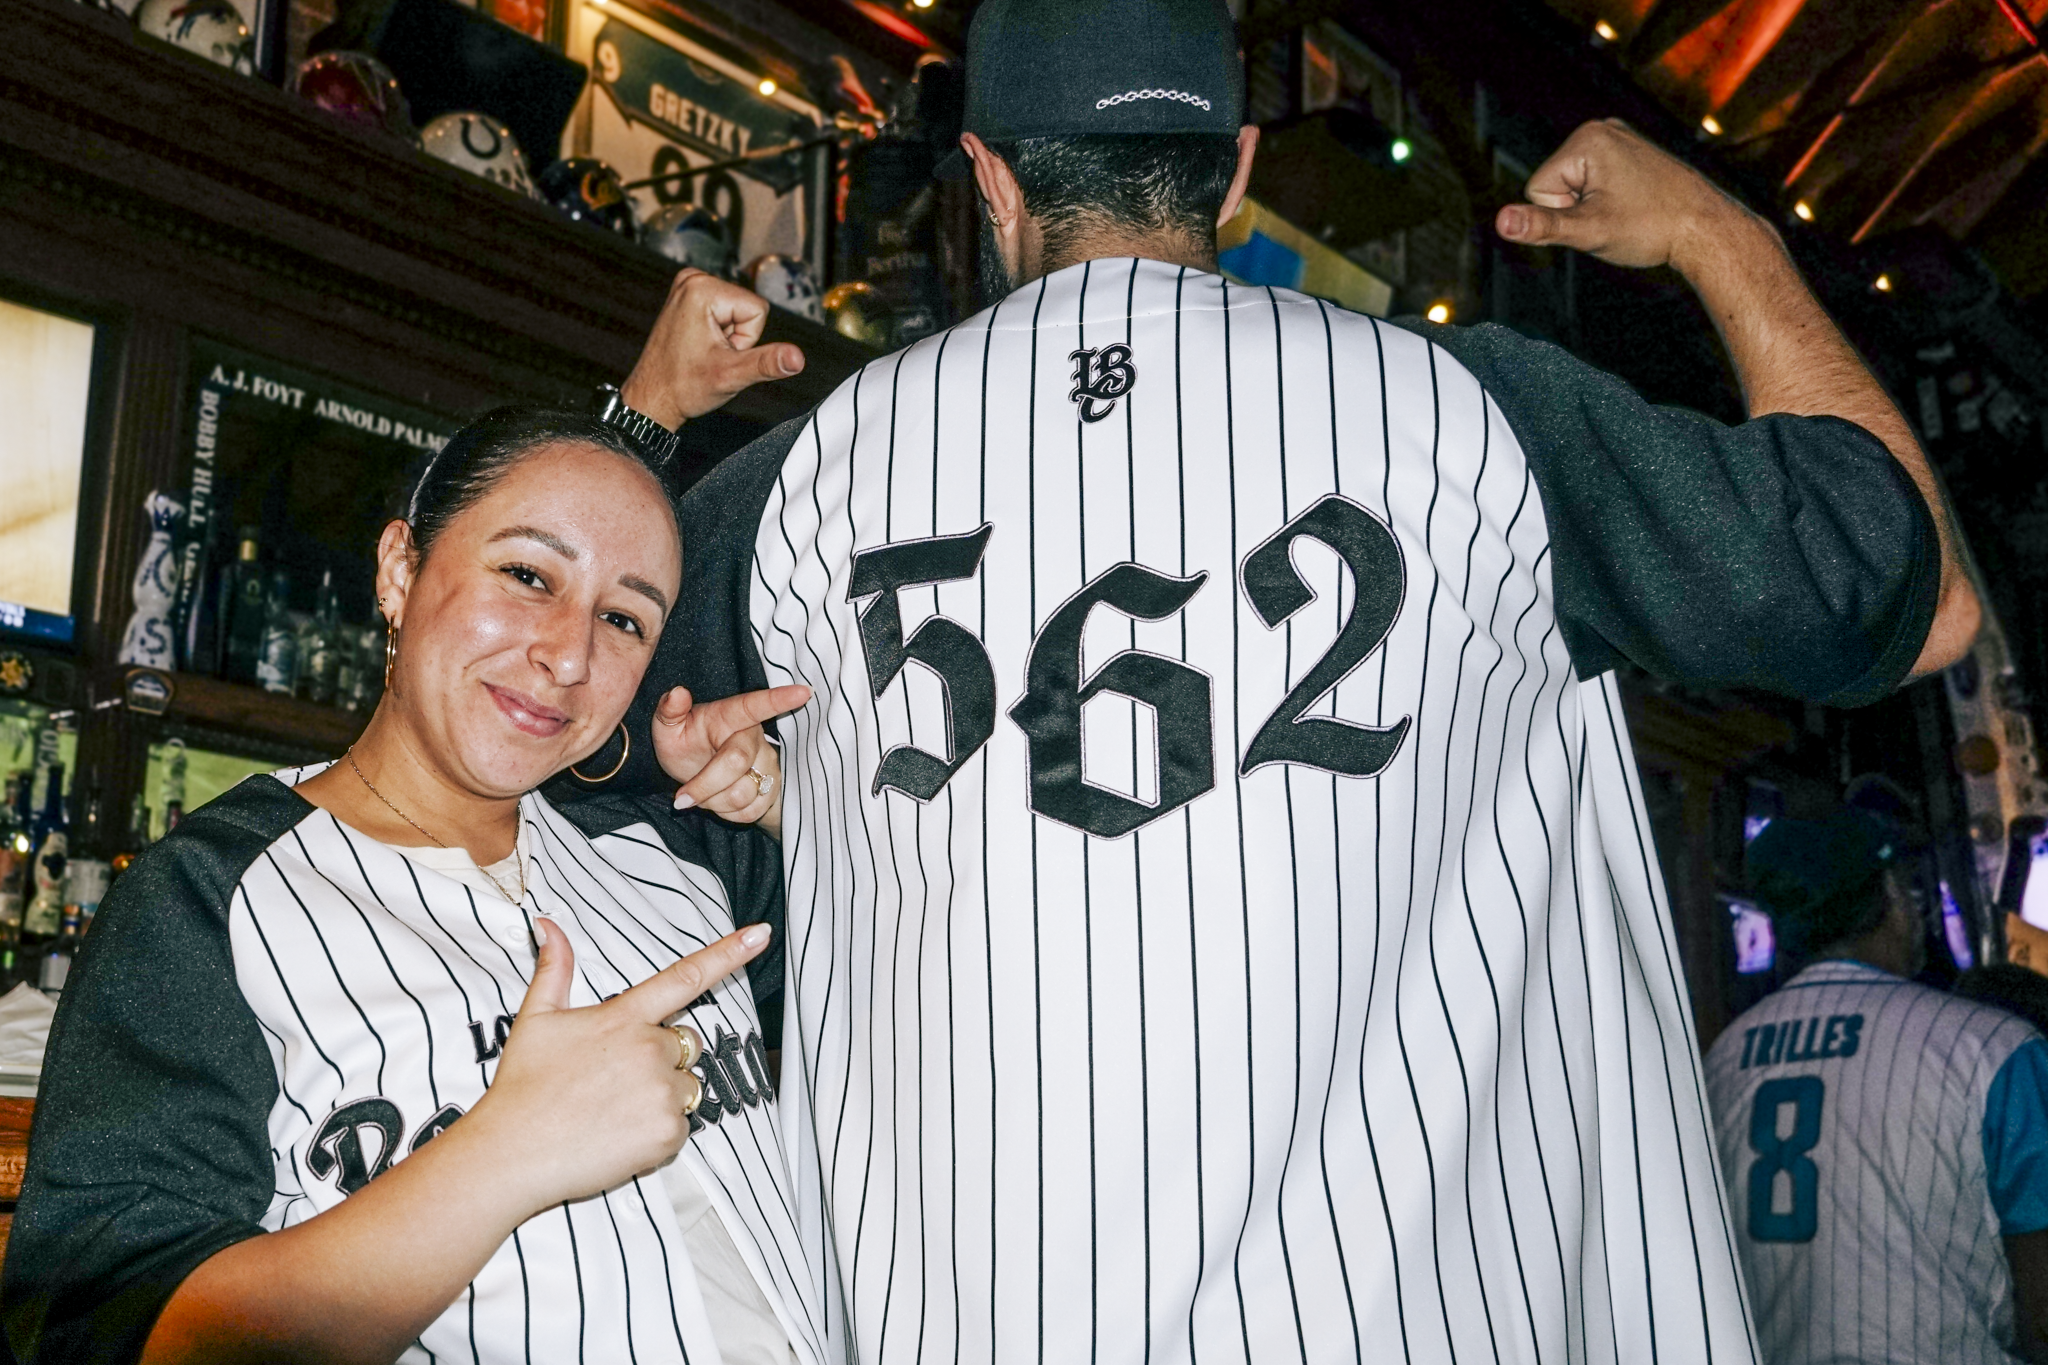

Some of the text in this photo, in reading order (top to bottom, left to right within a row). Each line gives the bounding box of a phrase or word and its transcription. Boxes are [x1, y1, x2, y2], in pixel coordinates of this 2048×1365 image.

[649, 83, 752, 158] GRETZKY
[194, 389, 221, 466] BOBBY
[252, 375, 306, 410] FOYT
[313, 397, 392, 438] ARNOLD
[187, 467, 214, 529] HULL
[846, 492, 1412, 841] 562
[1740, 1013, 1865, 1071] TRILLES
[1748, 1075, 1825, 1245] 8
